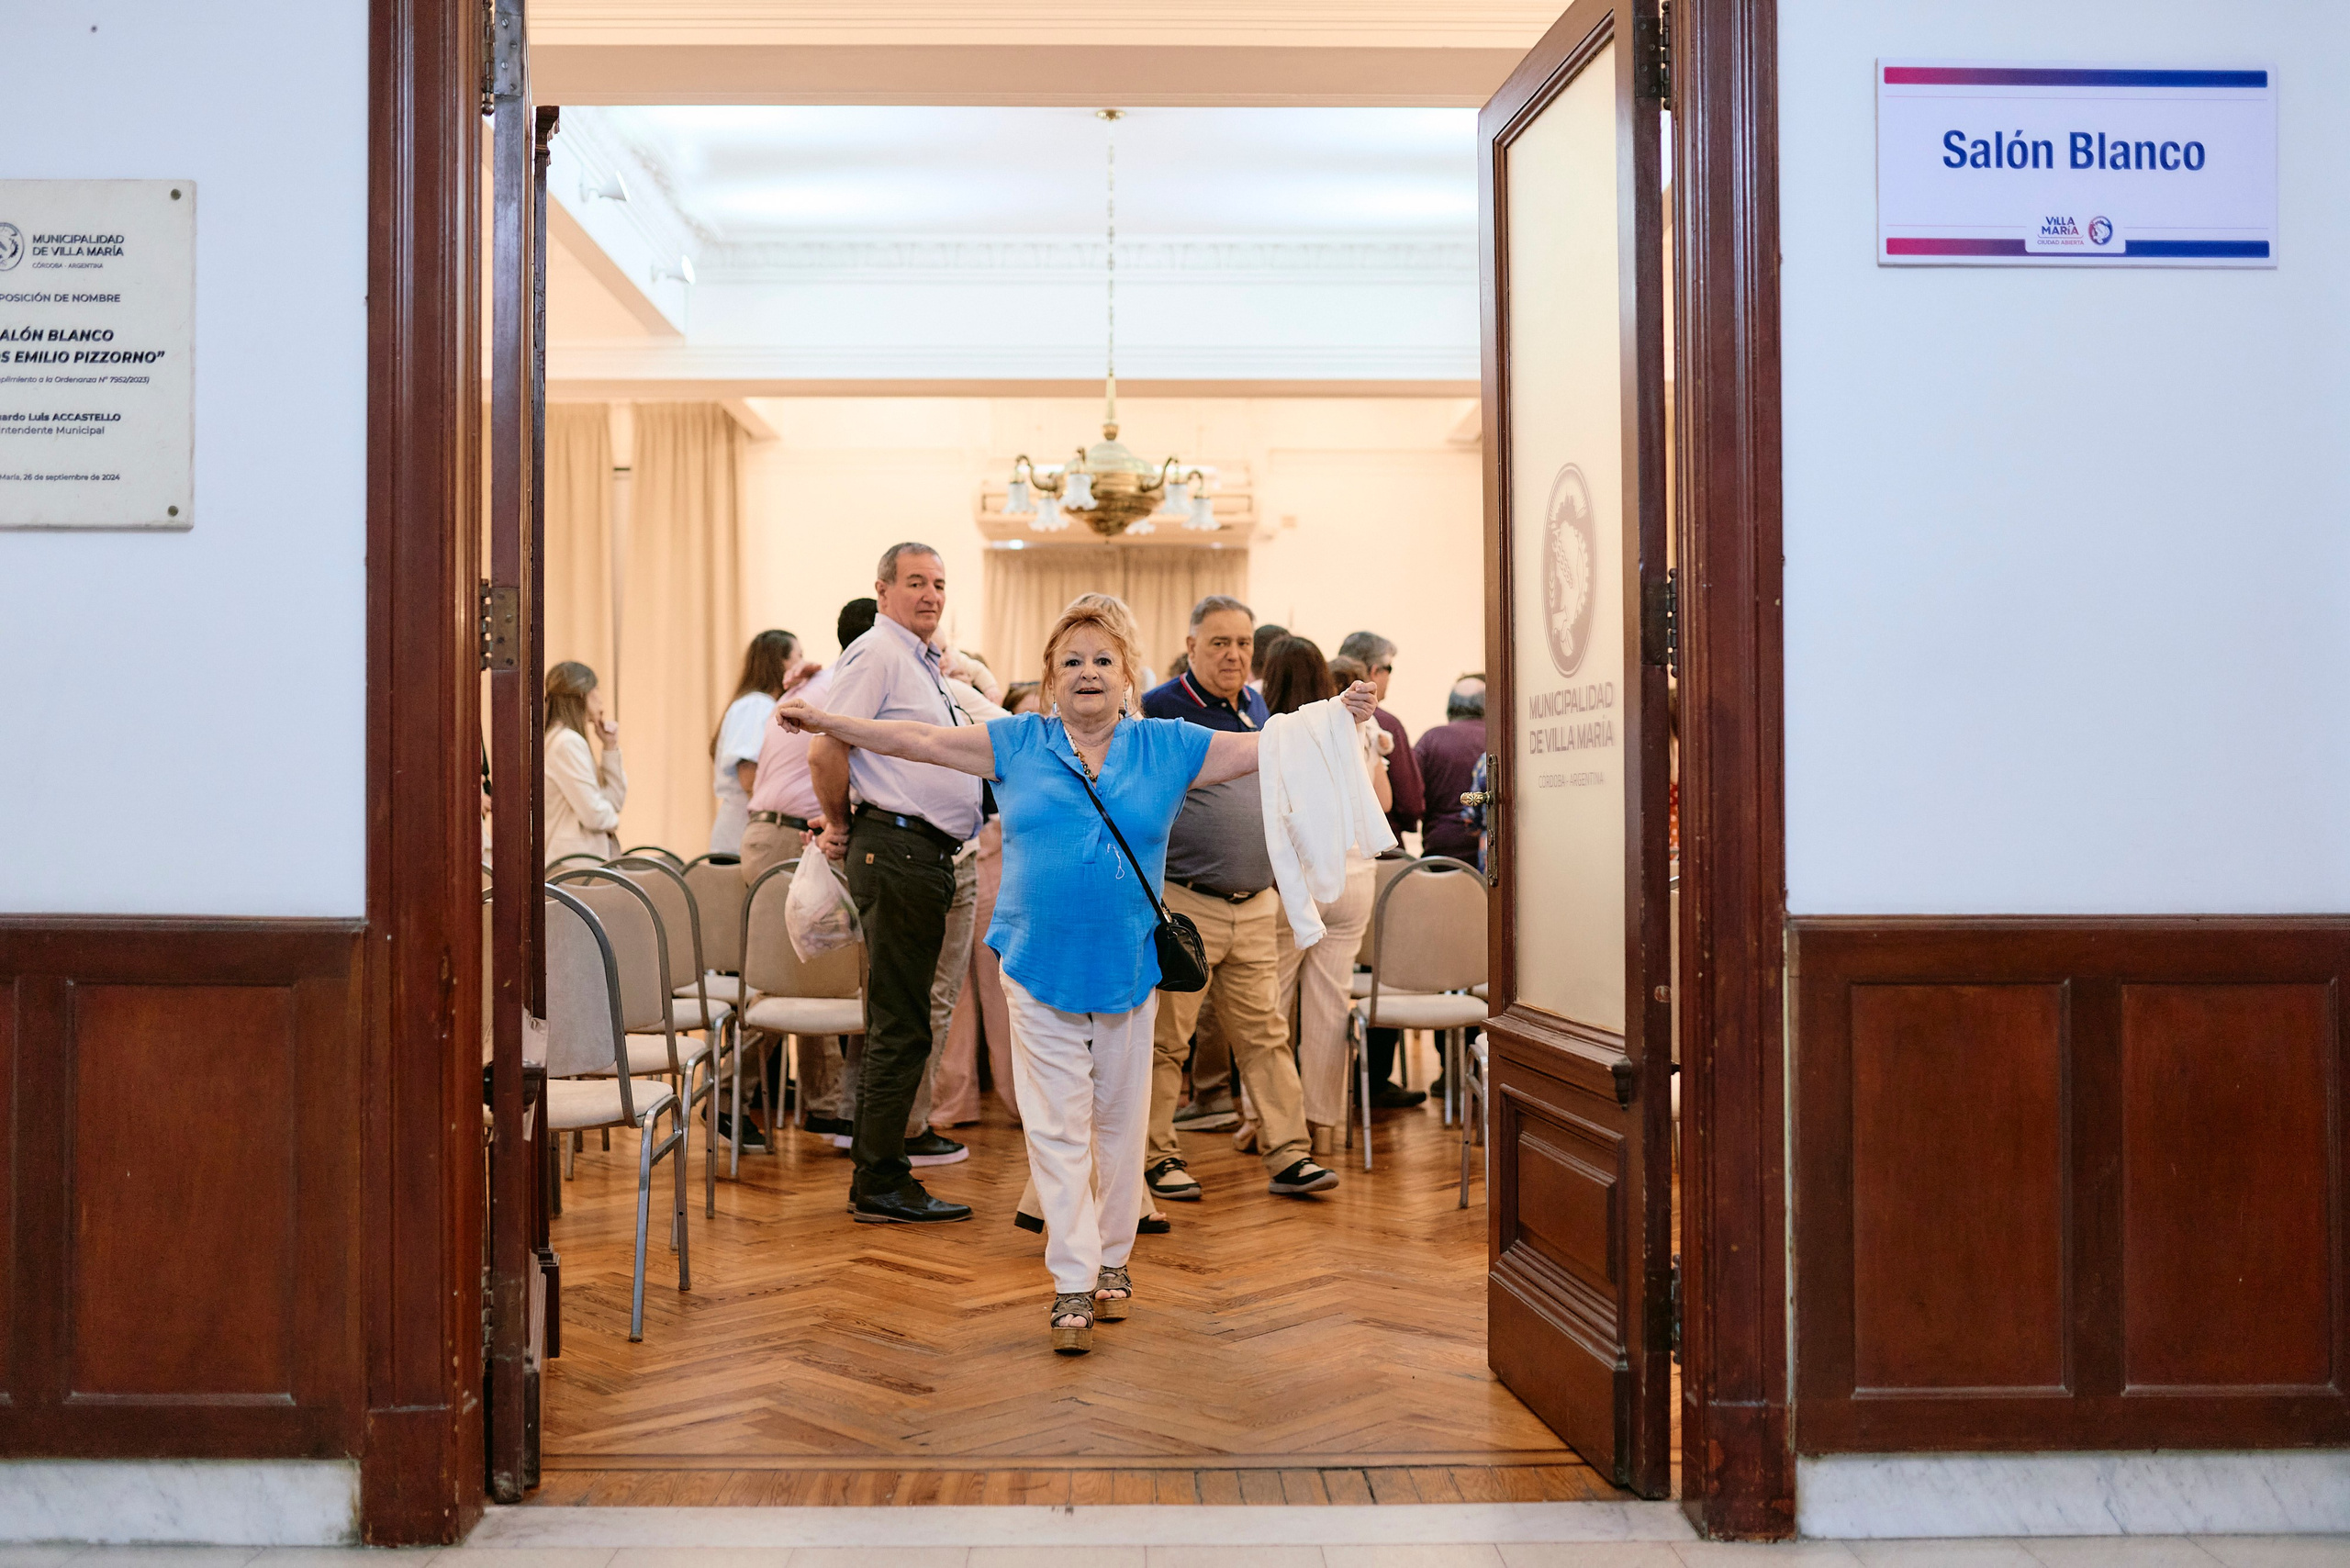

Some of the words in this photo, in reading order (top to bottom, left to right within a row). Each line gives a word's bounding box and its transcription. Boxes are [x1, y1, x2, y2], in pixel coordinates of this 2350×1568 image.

[1943, 129, 2053, 169] Salón
[2070, 132, 2205, 171] Blanco
[33, 235, 124, 244] MUNICIPALIDAD
[33, 247, 48, 255] DE
[51, 247, 84, 256] VILLA
[87, 245, 123, 256] MARÍA
[0, 292, 50, 302] POSICIÓN
[54, 294, 69, 302] DE
[72, 294, 120, 302] NOMBRE
[0, 326, 43, 342] ALÓN
[48, 330, 114, 342] BLANCO
[15, 351, 70, 363] EMILIO
[28, 412, 50, 421] Luis
[52, 413, 121, 421] ACCASTELLO
[1, 426, 53, 434] ntendente
[56, 426, 105, 436] Municipal
[1528, 681, 1614, 720] MUNICIPALIDAD
[1529, 730, 1543, 755] DE
[1545, 725, 1575, 752] VILLA
[1577, 715, 1614, 748] MARÍA
[1570, 772, 1604, 787] ARGENTINA
